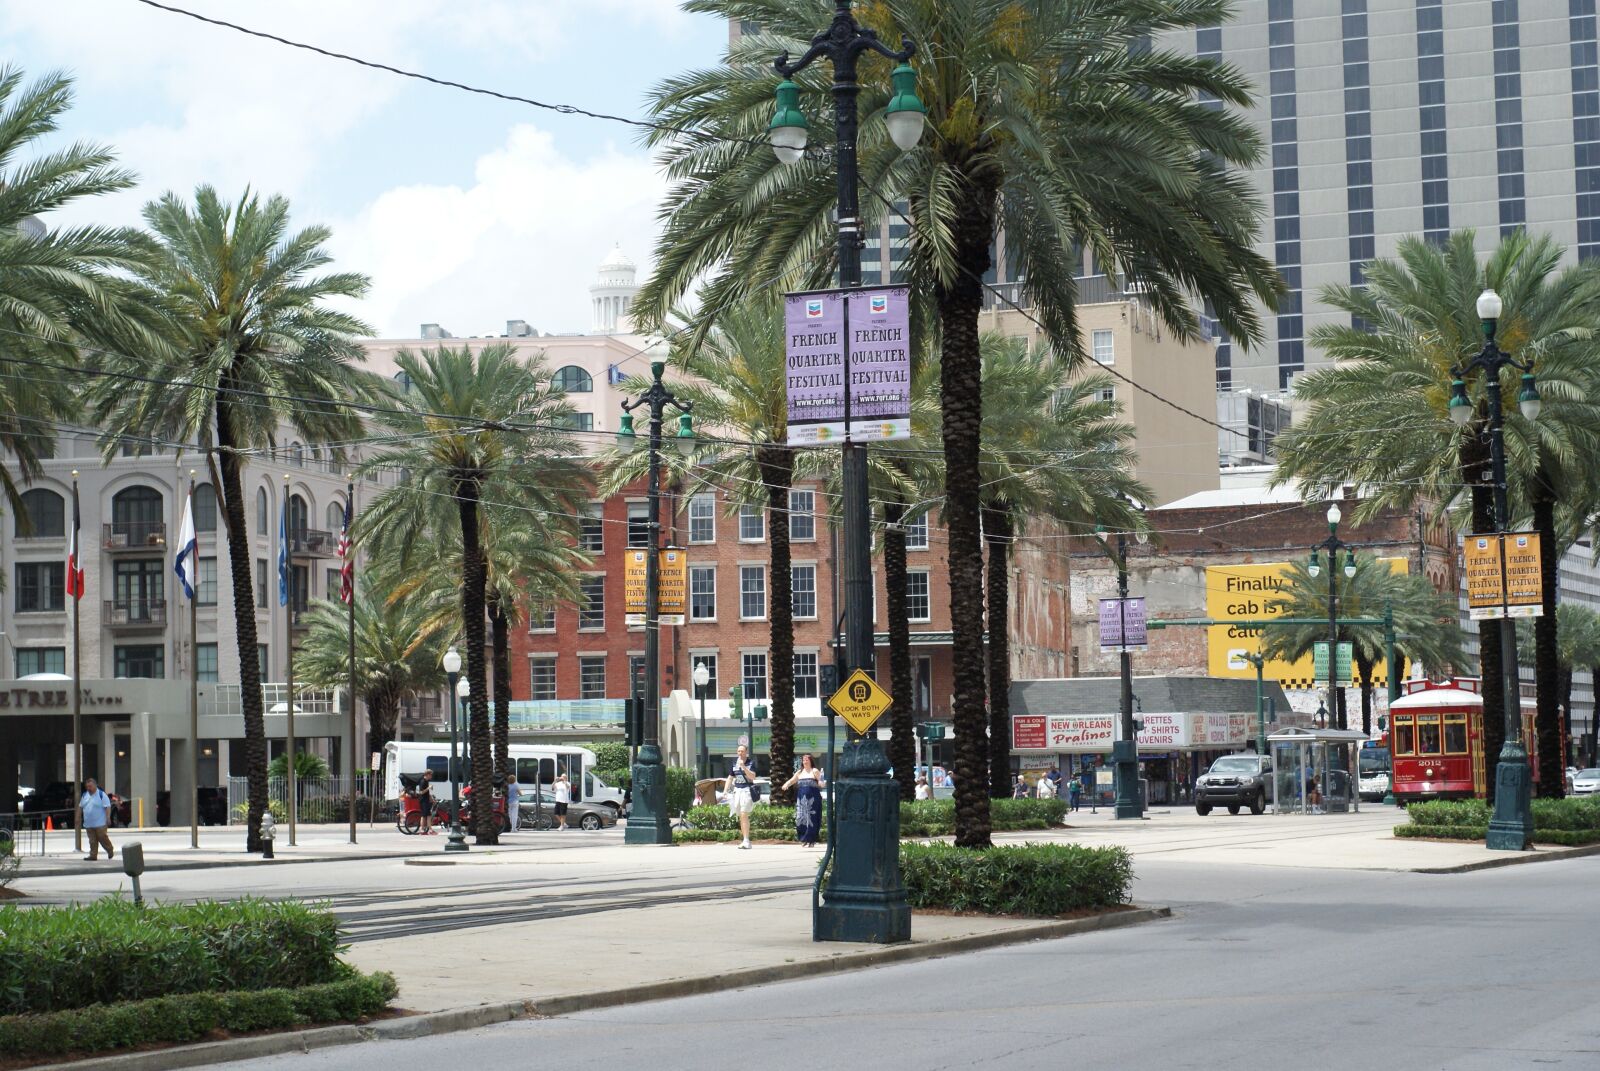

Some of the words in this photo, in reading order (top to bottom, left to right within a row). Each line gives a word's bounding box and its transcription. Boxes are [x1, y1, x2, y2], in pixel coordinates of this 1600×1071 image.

[792, 332, 838, 348] FRENCH
[856, 328, 902, 342] FRENCH
[788, 353, 842, 370] QUARTER
[852, 349, 906, 366] QUARTER
[788, 373, 842, 388] FESTIVAL
[852, 370, 908, 384] FESTIVAL
[1470, 557, 1496, 566] FRENCH
[1510, 555, 1536, 564] FRENCH
[1469, 568, 1499, 577] QUARTER
[1508, 567, 1538, 575] QUARTER
[1226, 576, 1283, 594] Finally
[1470, 580, 1501, 588] FESTIVAL
[1508, 578, 1540, 586] FESTIVAL
[1227, 600, 1258, 615] cab
[1264, 600, 1277, 614] is
[80, 696, 122, 705] ILTON
[1051, 721, 1070, 730] NEW
[1072, 720, 1112, 730] ORLEANS
[1151, 726, 1180, 734] SHIRTS
[1052, 730, 1112, 744] Pralines
[1138, 736, 1173, 744] UVENIRS
